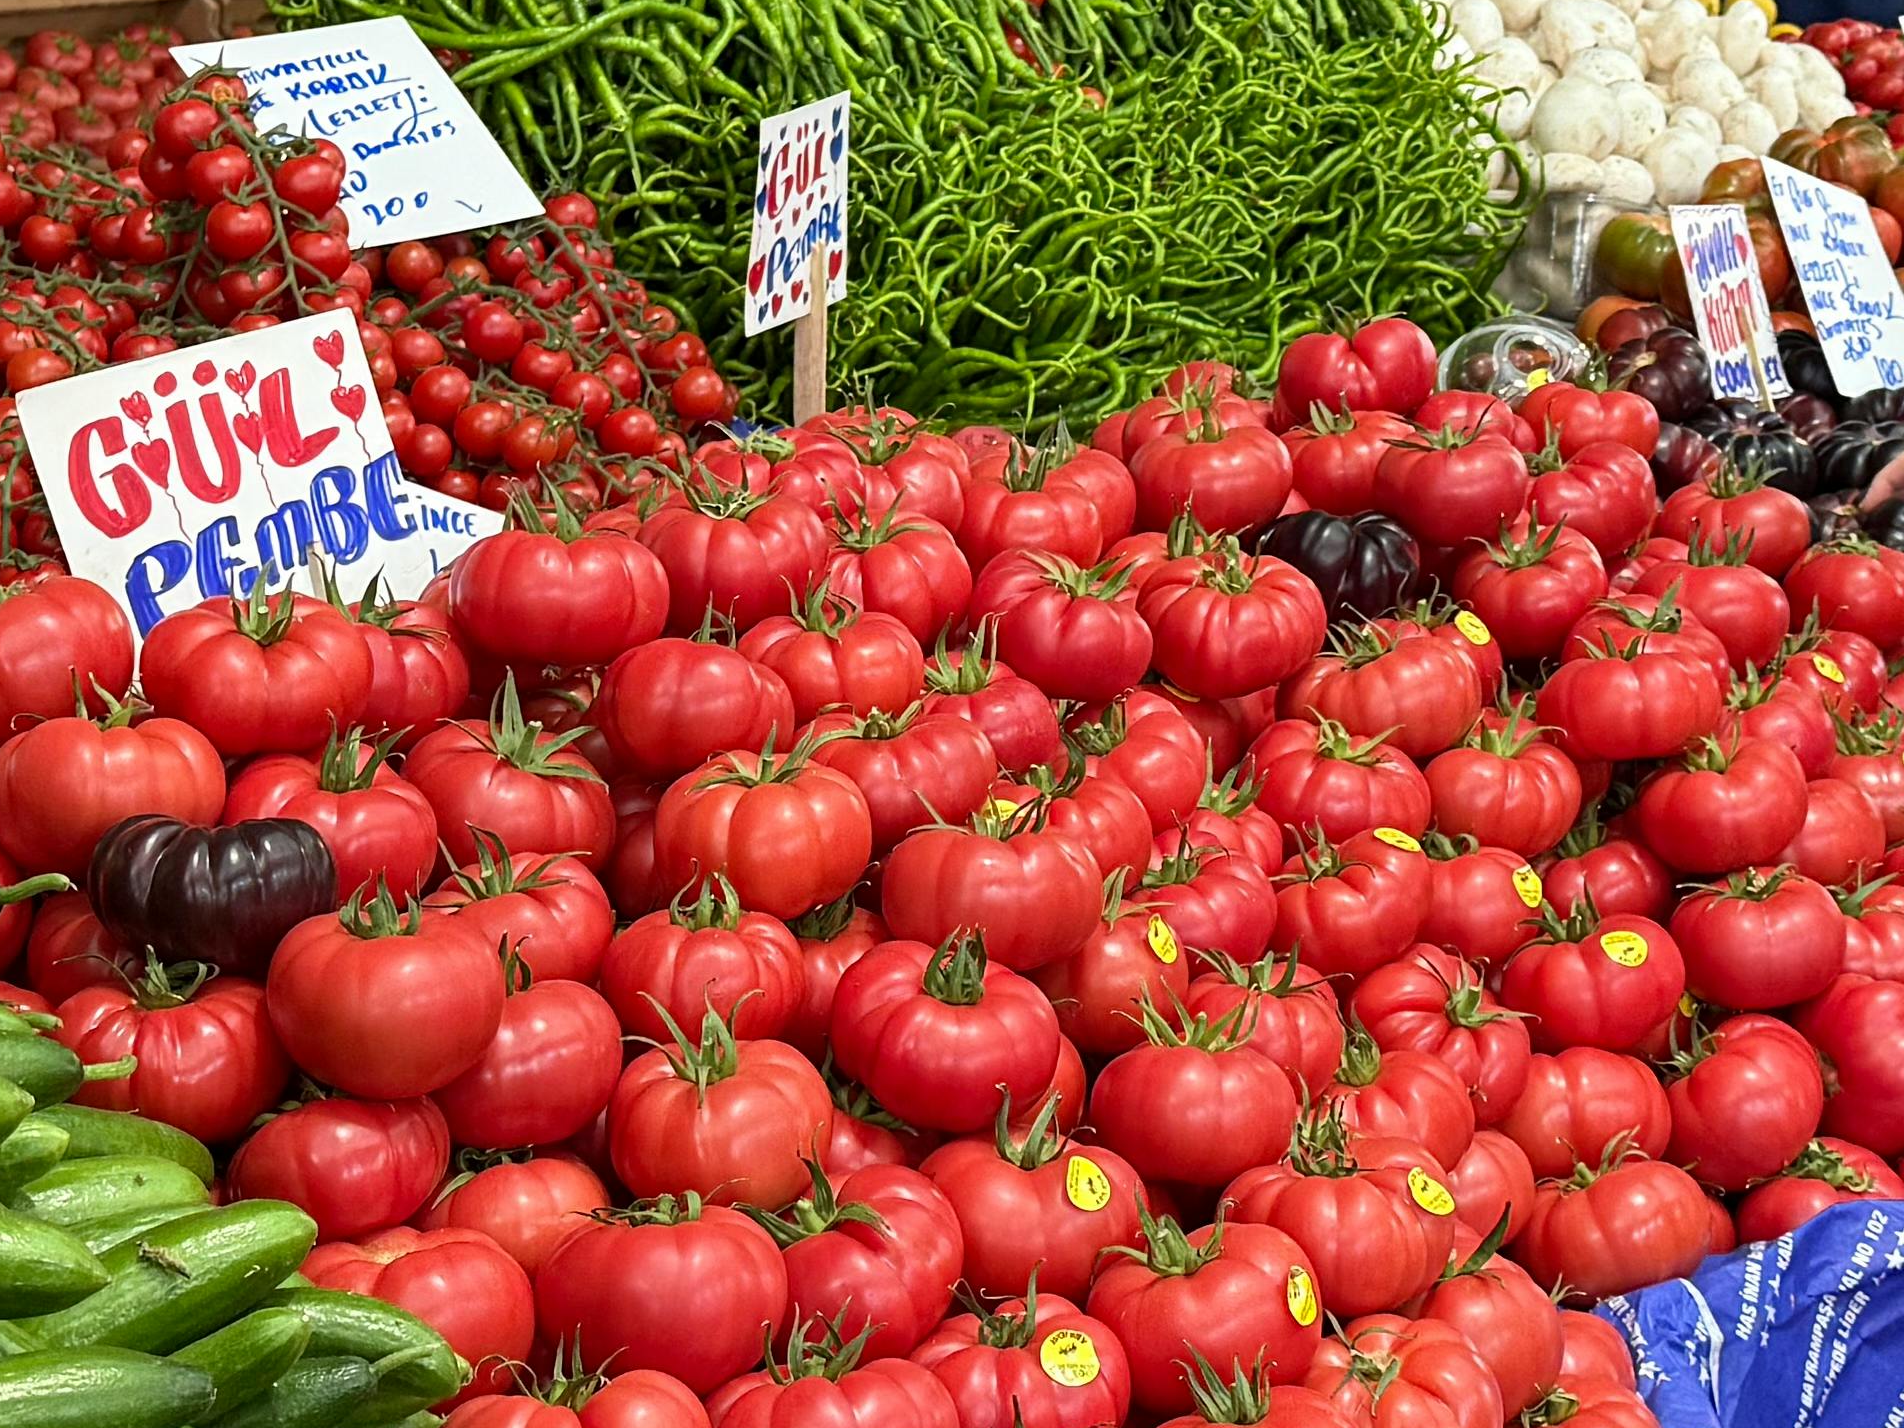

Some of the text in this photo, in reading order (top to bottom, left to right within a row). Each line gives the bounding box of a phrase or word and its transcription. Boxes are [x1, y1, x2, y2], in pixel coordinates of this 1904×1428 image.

[768, 123, 827, 220] GÜL
[767, 195, 842, 296] PEMBE
[68, 360, 340, 539] GÜL
[125, 450, 420, 640] PEMBE
